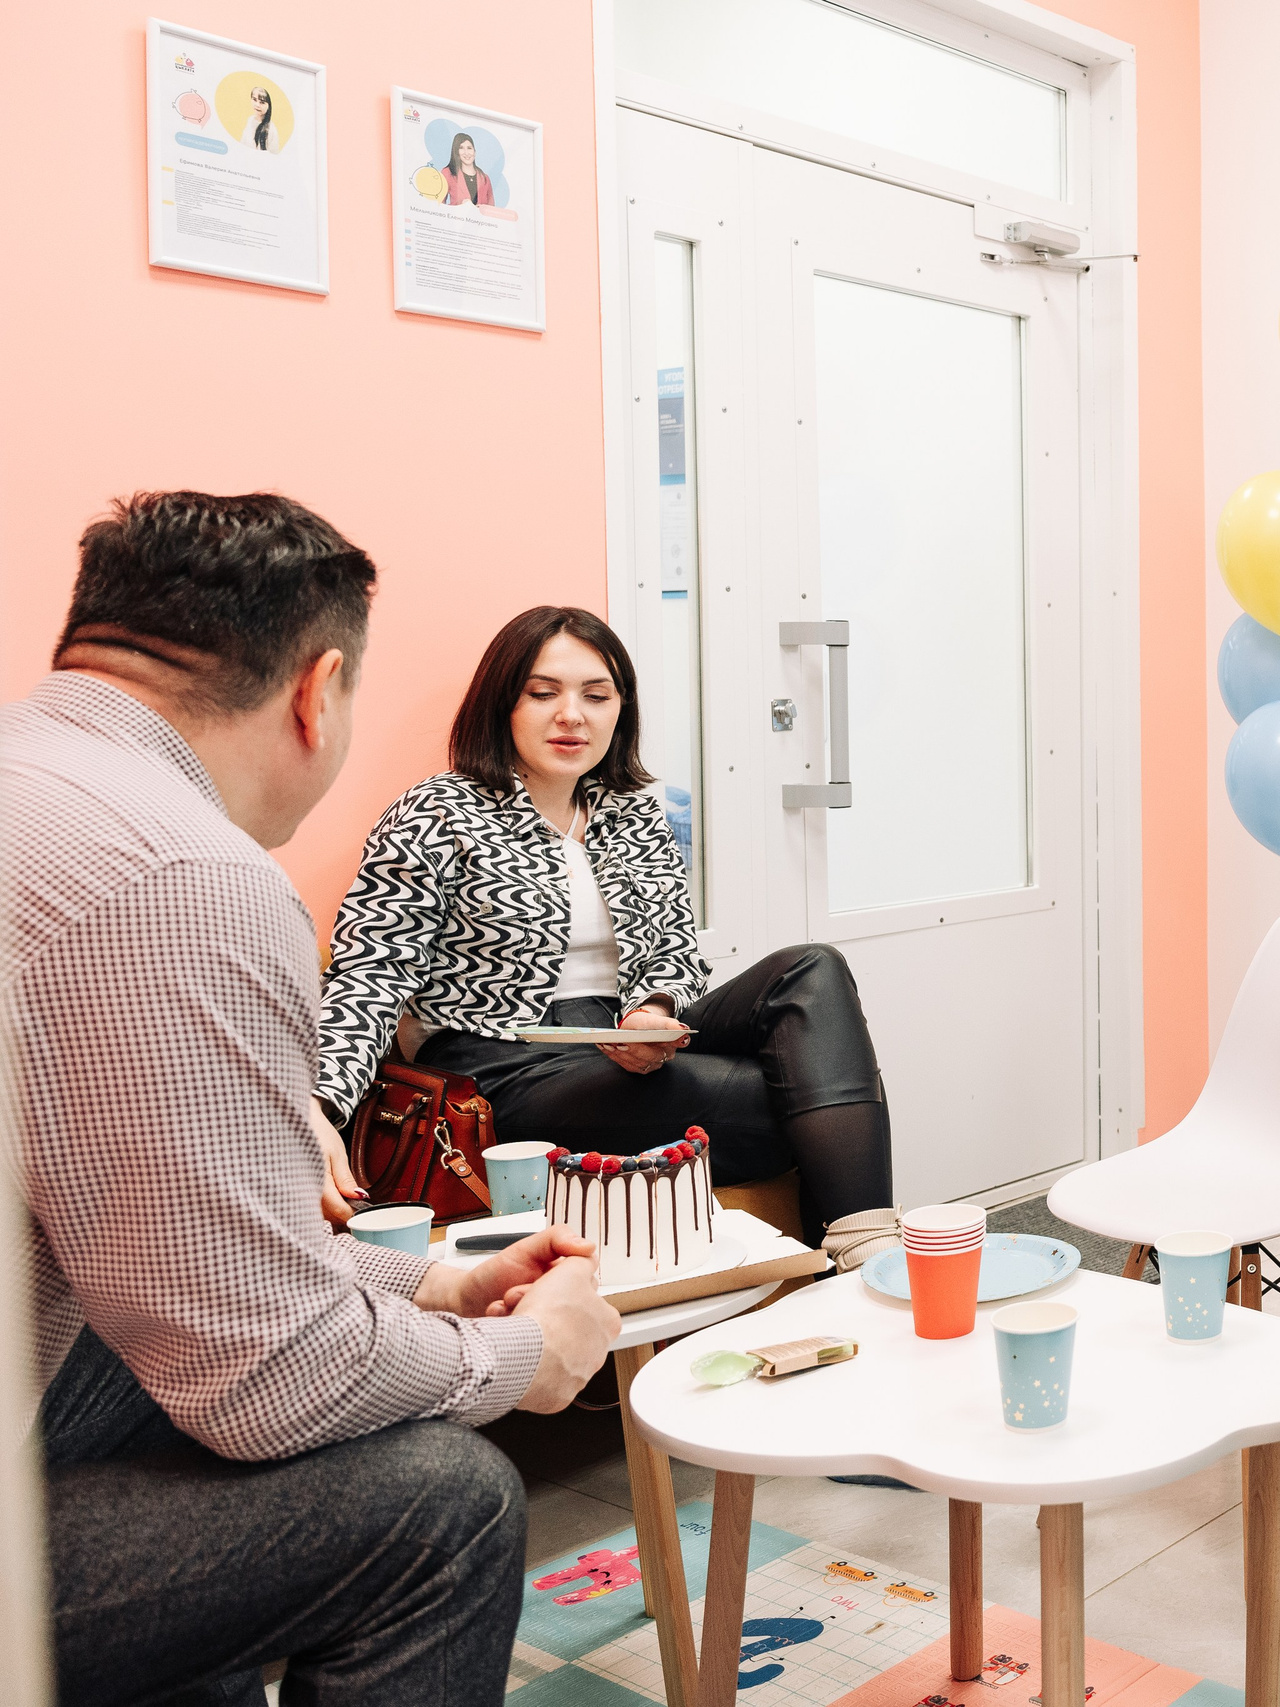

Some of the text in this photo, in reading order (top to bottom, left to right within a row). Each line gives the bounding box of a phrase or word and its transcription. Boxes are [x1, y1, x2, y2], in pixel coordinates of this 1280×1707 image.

[205, 164, 226, 173] Валерия
[228, 170, 261, 180] Анатольевна
[447, 213, 464, 222] Елена
[830, 1595, 860, 1612] two
